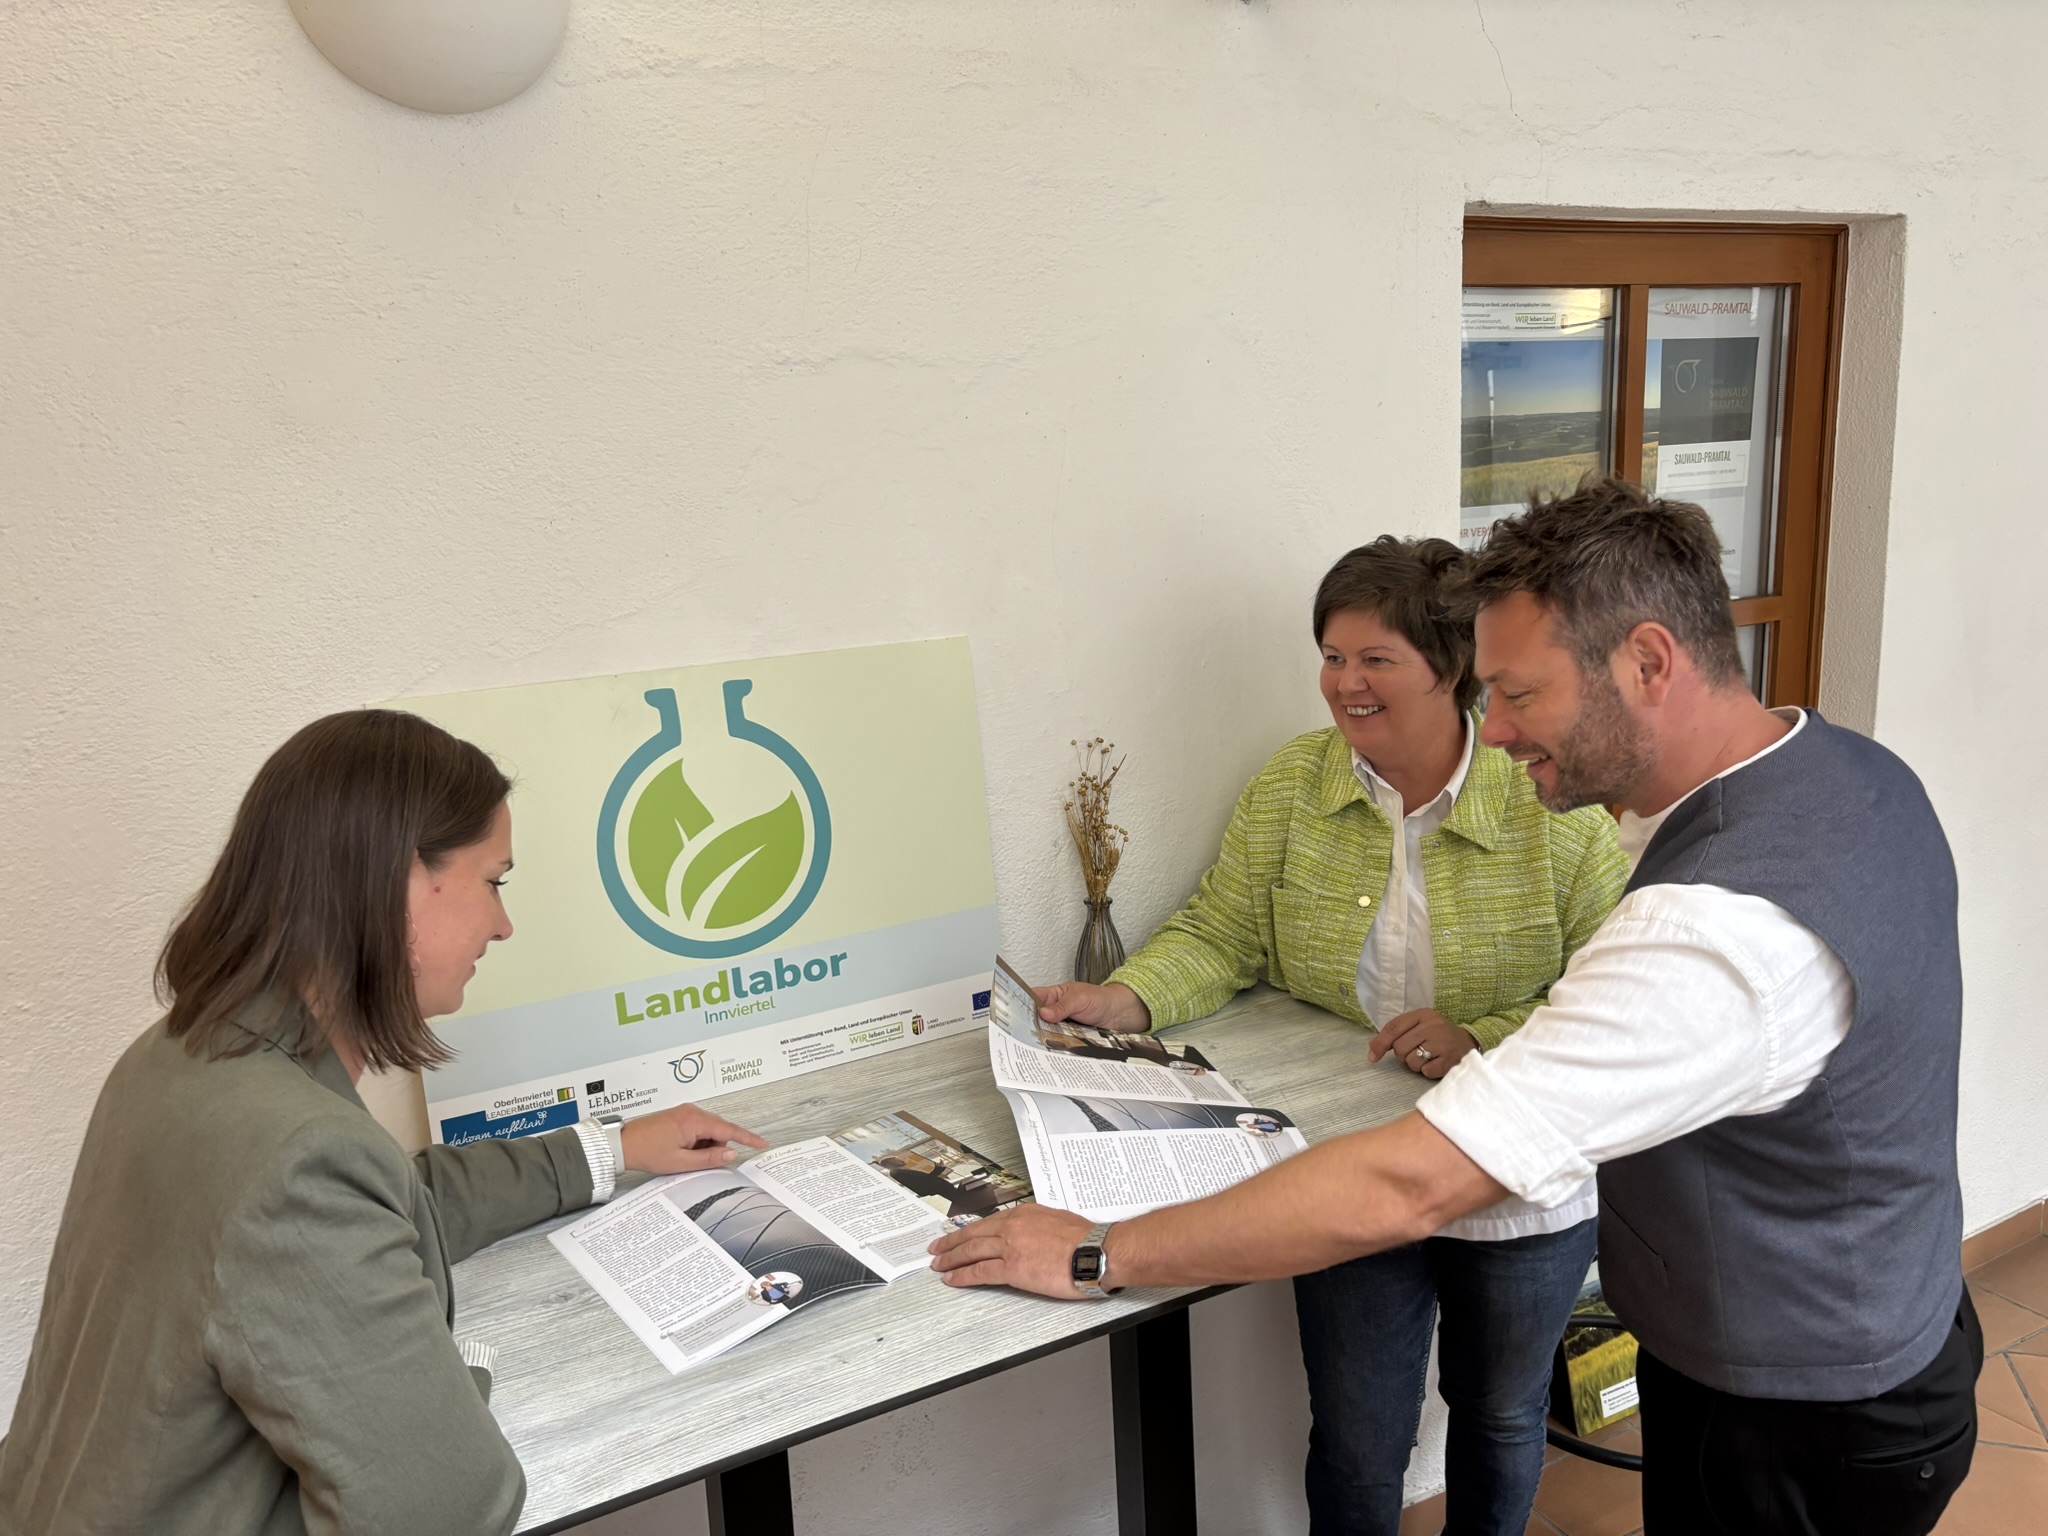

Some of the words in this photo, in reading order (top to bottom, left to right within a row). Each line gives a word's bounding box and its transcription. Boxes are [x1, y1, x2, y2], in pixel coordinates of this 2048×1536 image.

[1665, 303, 1753, 315] SAUWALD-PRAMTAL
[1675, 451, 1731, 465] SAUWALD-PRAMTAL
[615, 952, 848, 1026] Landlabor
[705, 997, 776, 1024] Innviertel
[790, 1032, 824, 1043] Unterstützung
[870, 1013, 898, 1023] Europäischer
[850, 1034, 868, 1044] WIR
[869, 1031, 885, 1039] leben
[886, 1025, 901, 1034] Land
[721, 1059, 763, 1075] SAUWALD
[722, 1068, 762, 1084] PRAMTAL
[636, 1087, 659, 1098] REGION
[590, 1108, 611, 1118] Mitten
[621, 1098, 652, 1112] Innviertel
